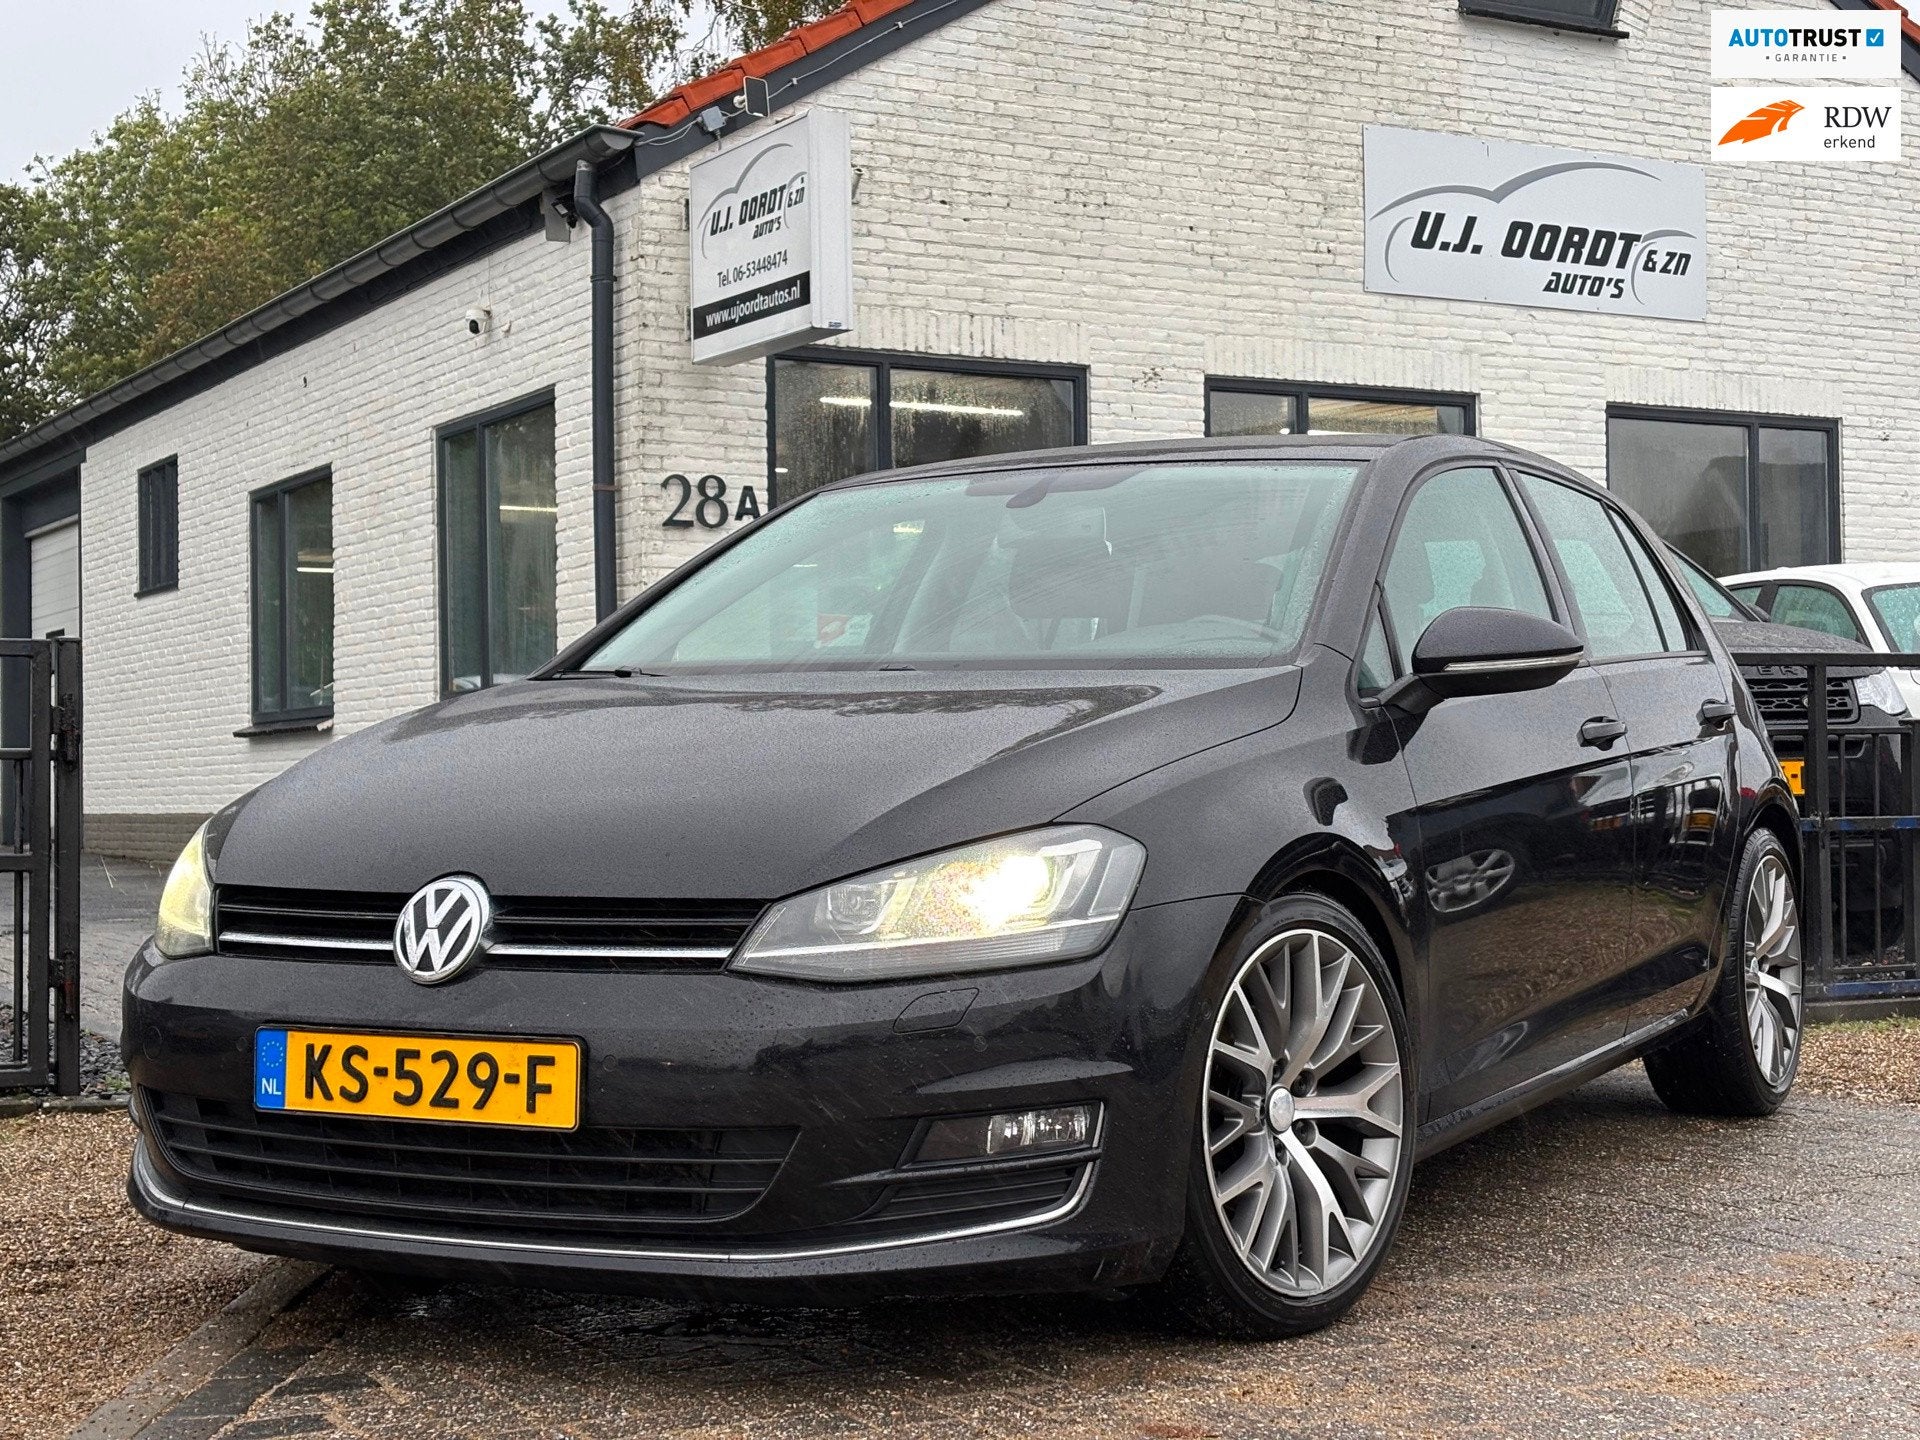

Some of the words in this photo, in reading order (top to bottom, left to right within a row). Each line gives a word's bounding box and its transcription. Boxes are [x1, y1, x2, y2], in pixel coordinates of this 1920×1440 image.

[710, 206, 733, 236] U.J.
[739, 184, 787, 225] OORDT
[1411, 211, 1483, 254] U.J.
[1501, 221, 1642, 269] OORDT
[717, 268, 731, 288] Tel.
[733, 249, 788, 283] 06-53448474
[705, 280, 800, 327] www.ujoordtautos.nl
[1757, 665, 1807, 676] ER
[261, 1077, 282, 1096] NL
[305, 1043, 556, 1114] KS-529-F
